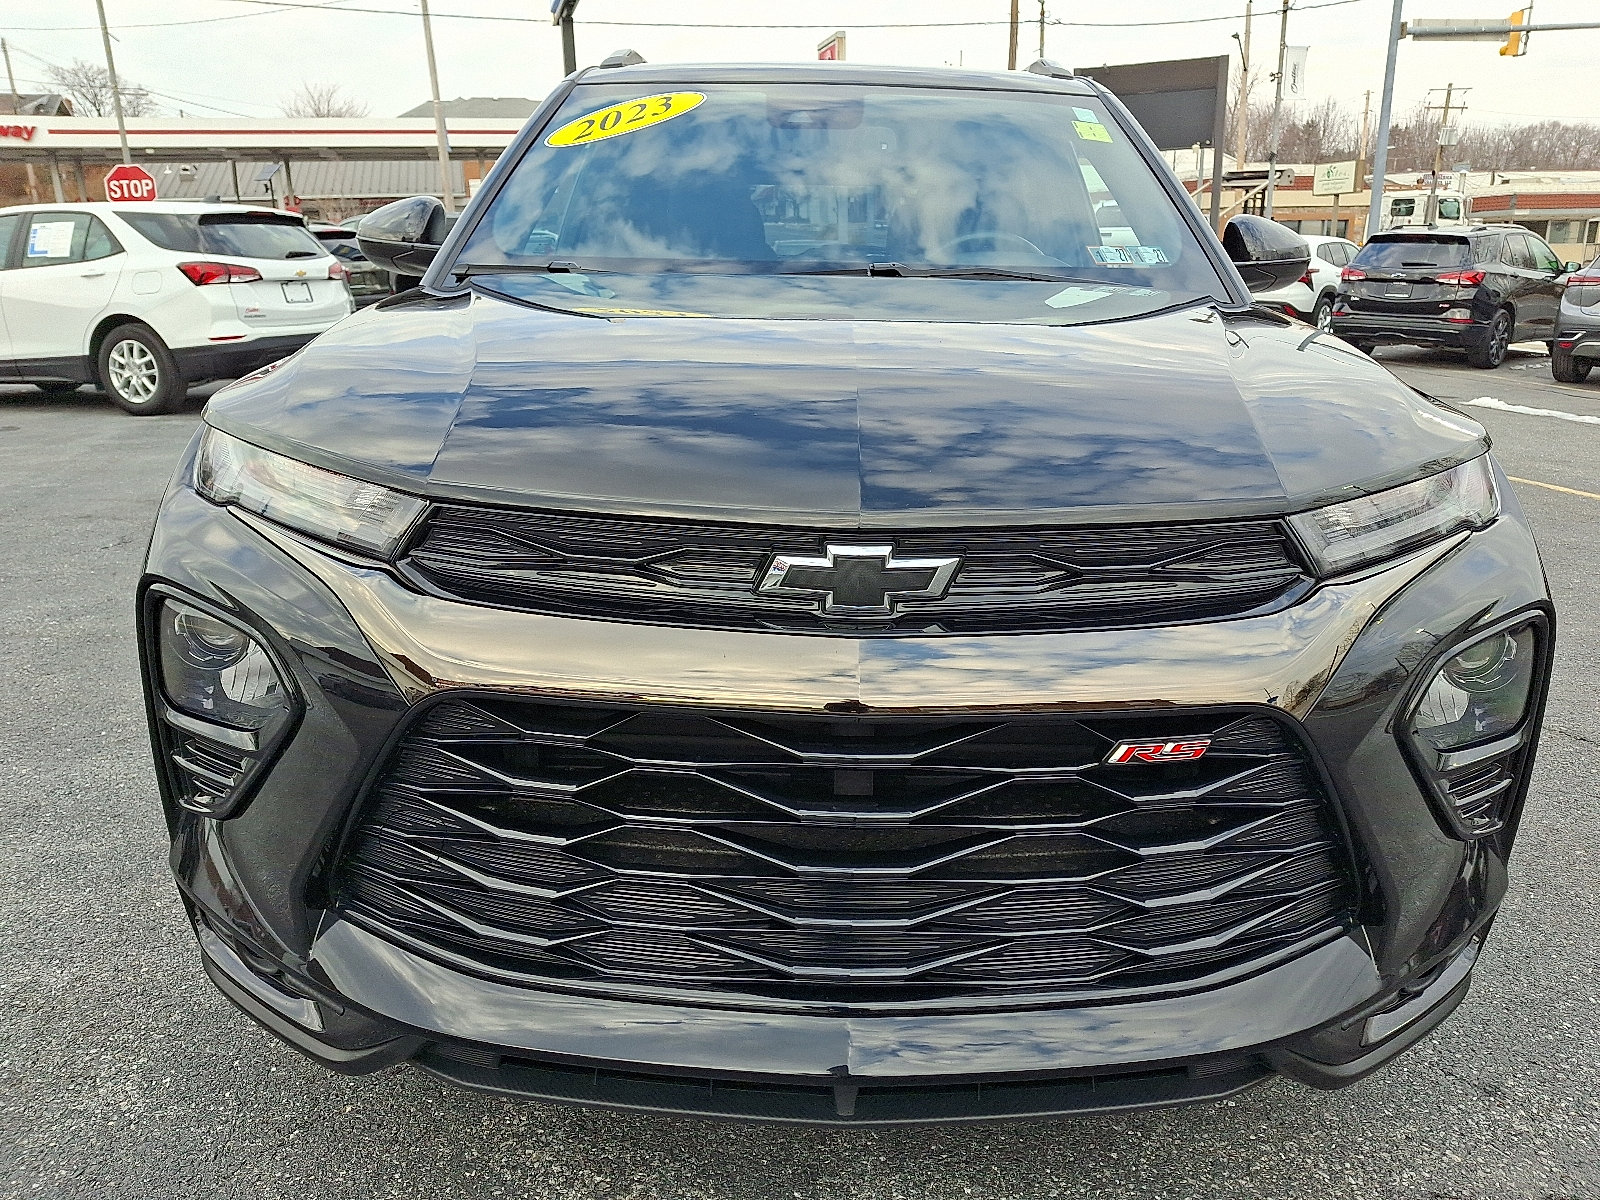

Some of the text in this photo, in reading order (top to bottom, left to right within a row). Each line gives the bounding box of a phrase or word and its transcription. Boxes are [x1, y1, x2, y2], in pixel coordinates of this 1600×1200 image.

[573, 97, 672, 141] 2023
[109, 179, 153, 199] STOP
[1108, 740, 1211, 763] RS
